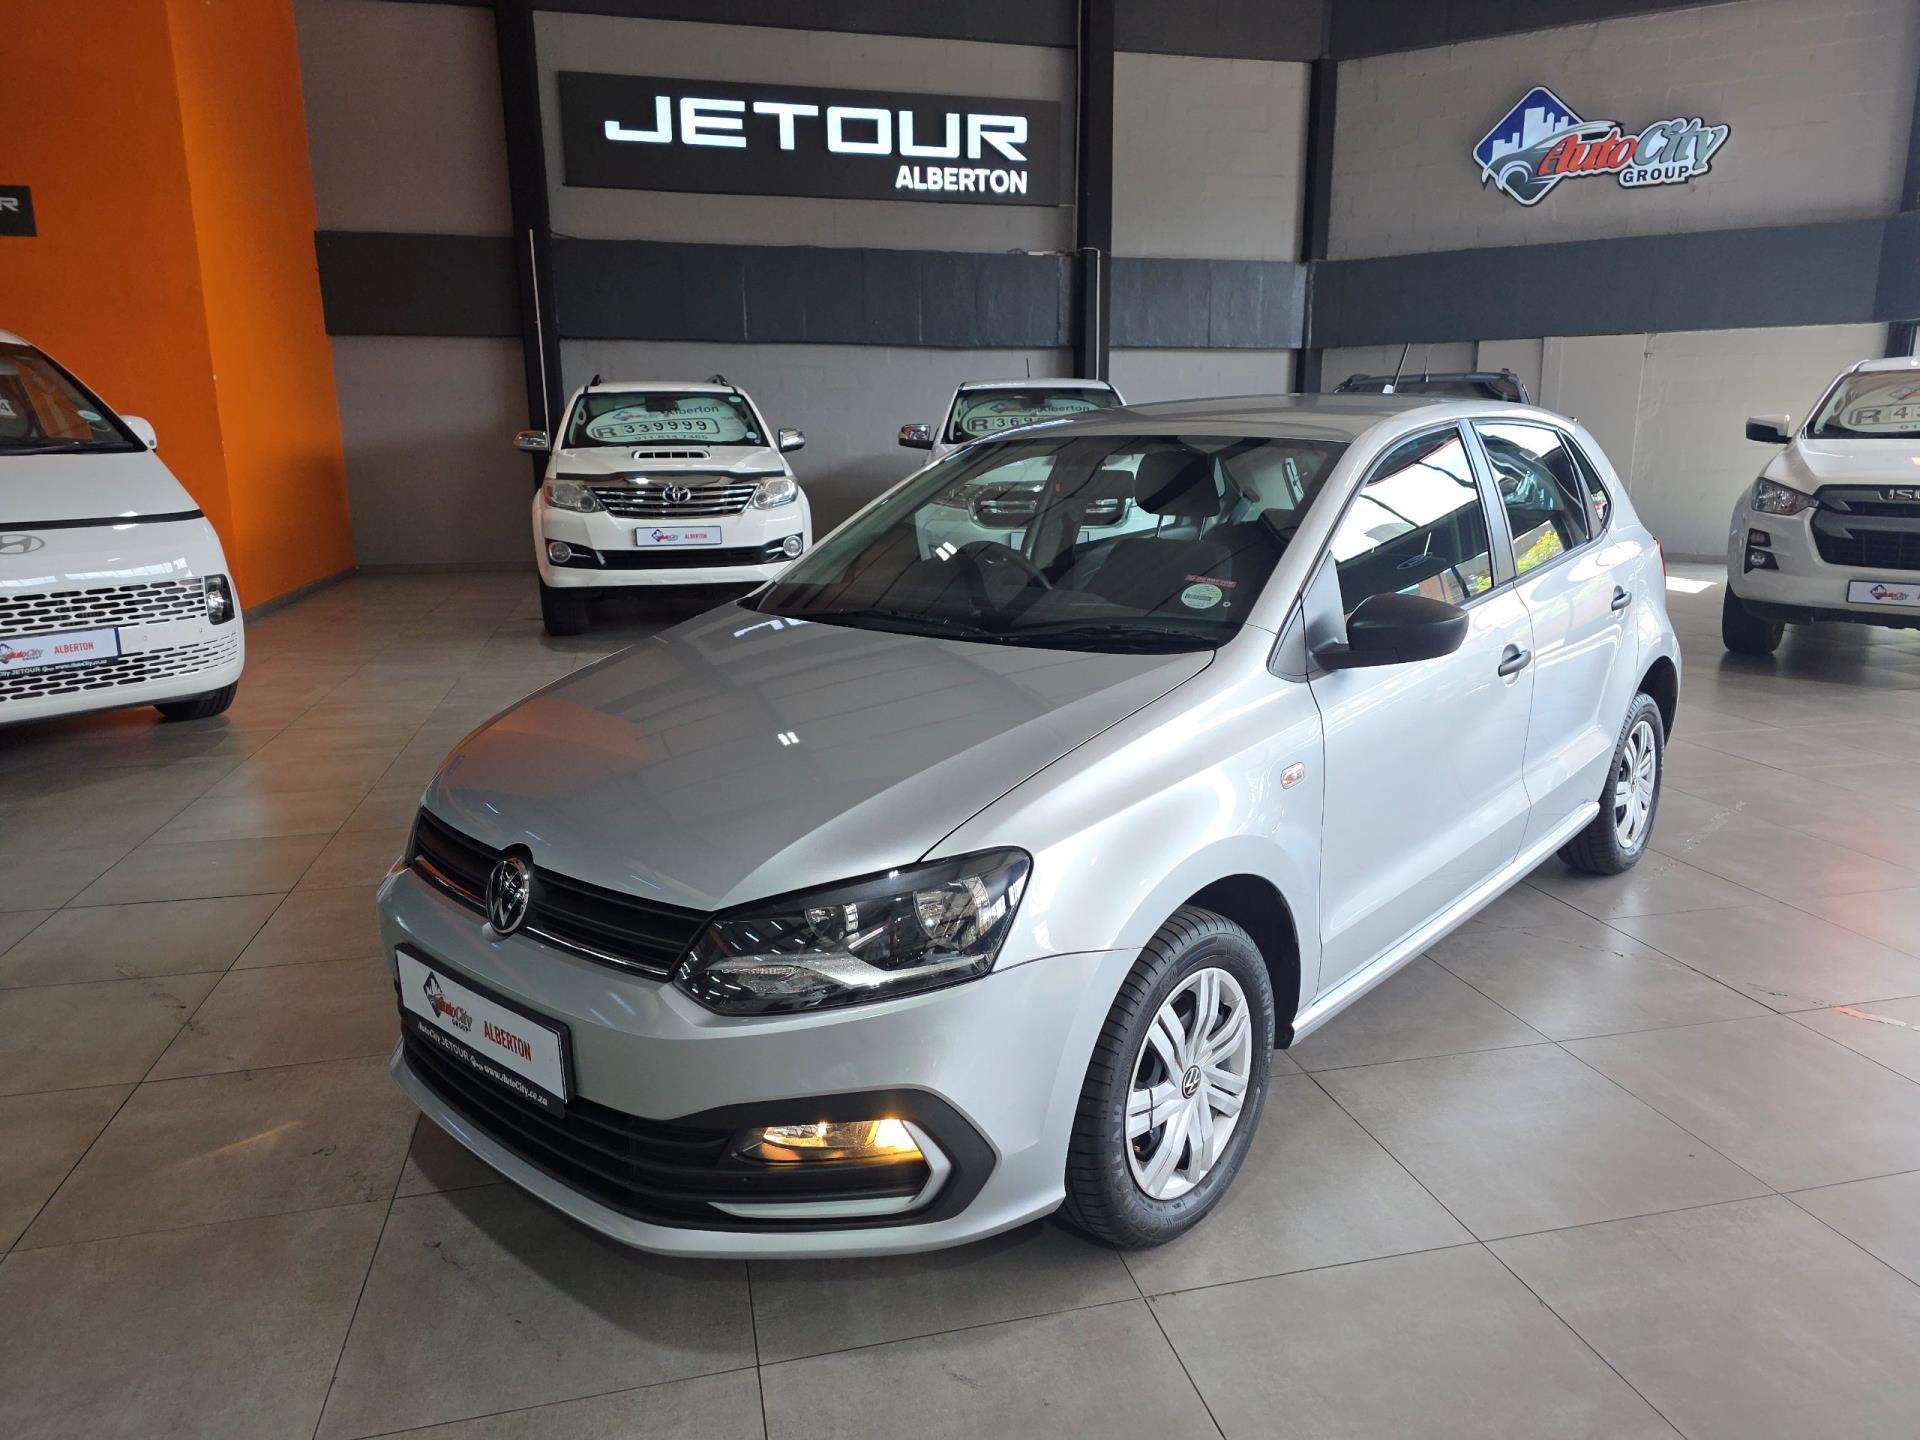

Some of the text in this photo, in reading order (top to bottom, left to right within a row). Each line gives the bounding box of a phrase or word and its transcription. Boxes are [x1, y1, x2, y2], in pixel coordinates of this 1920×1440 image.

[604, 95, 1028, 162] JETOUR
[1538, 120, 1727, 176] AutoCity
[895, 165, 1028, 194] ALBERTON
[1622, 165, 1691, 184] GROUP
[1895, 406, 1920, 419] 4
[624, 420, 707, 433] 339999
[54, 642, 94, 654] ALBERTON
[441, 1036, 470, 1062] JETOUR
[484, 1020, 532, 1062] ALBERTON
